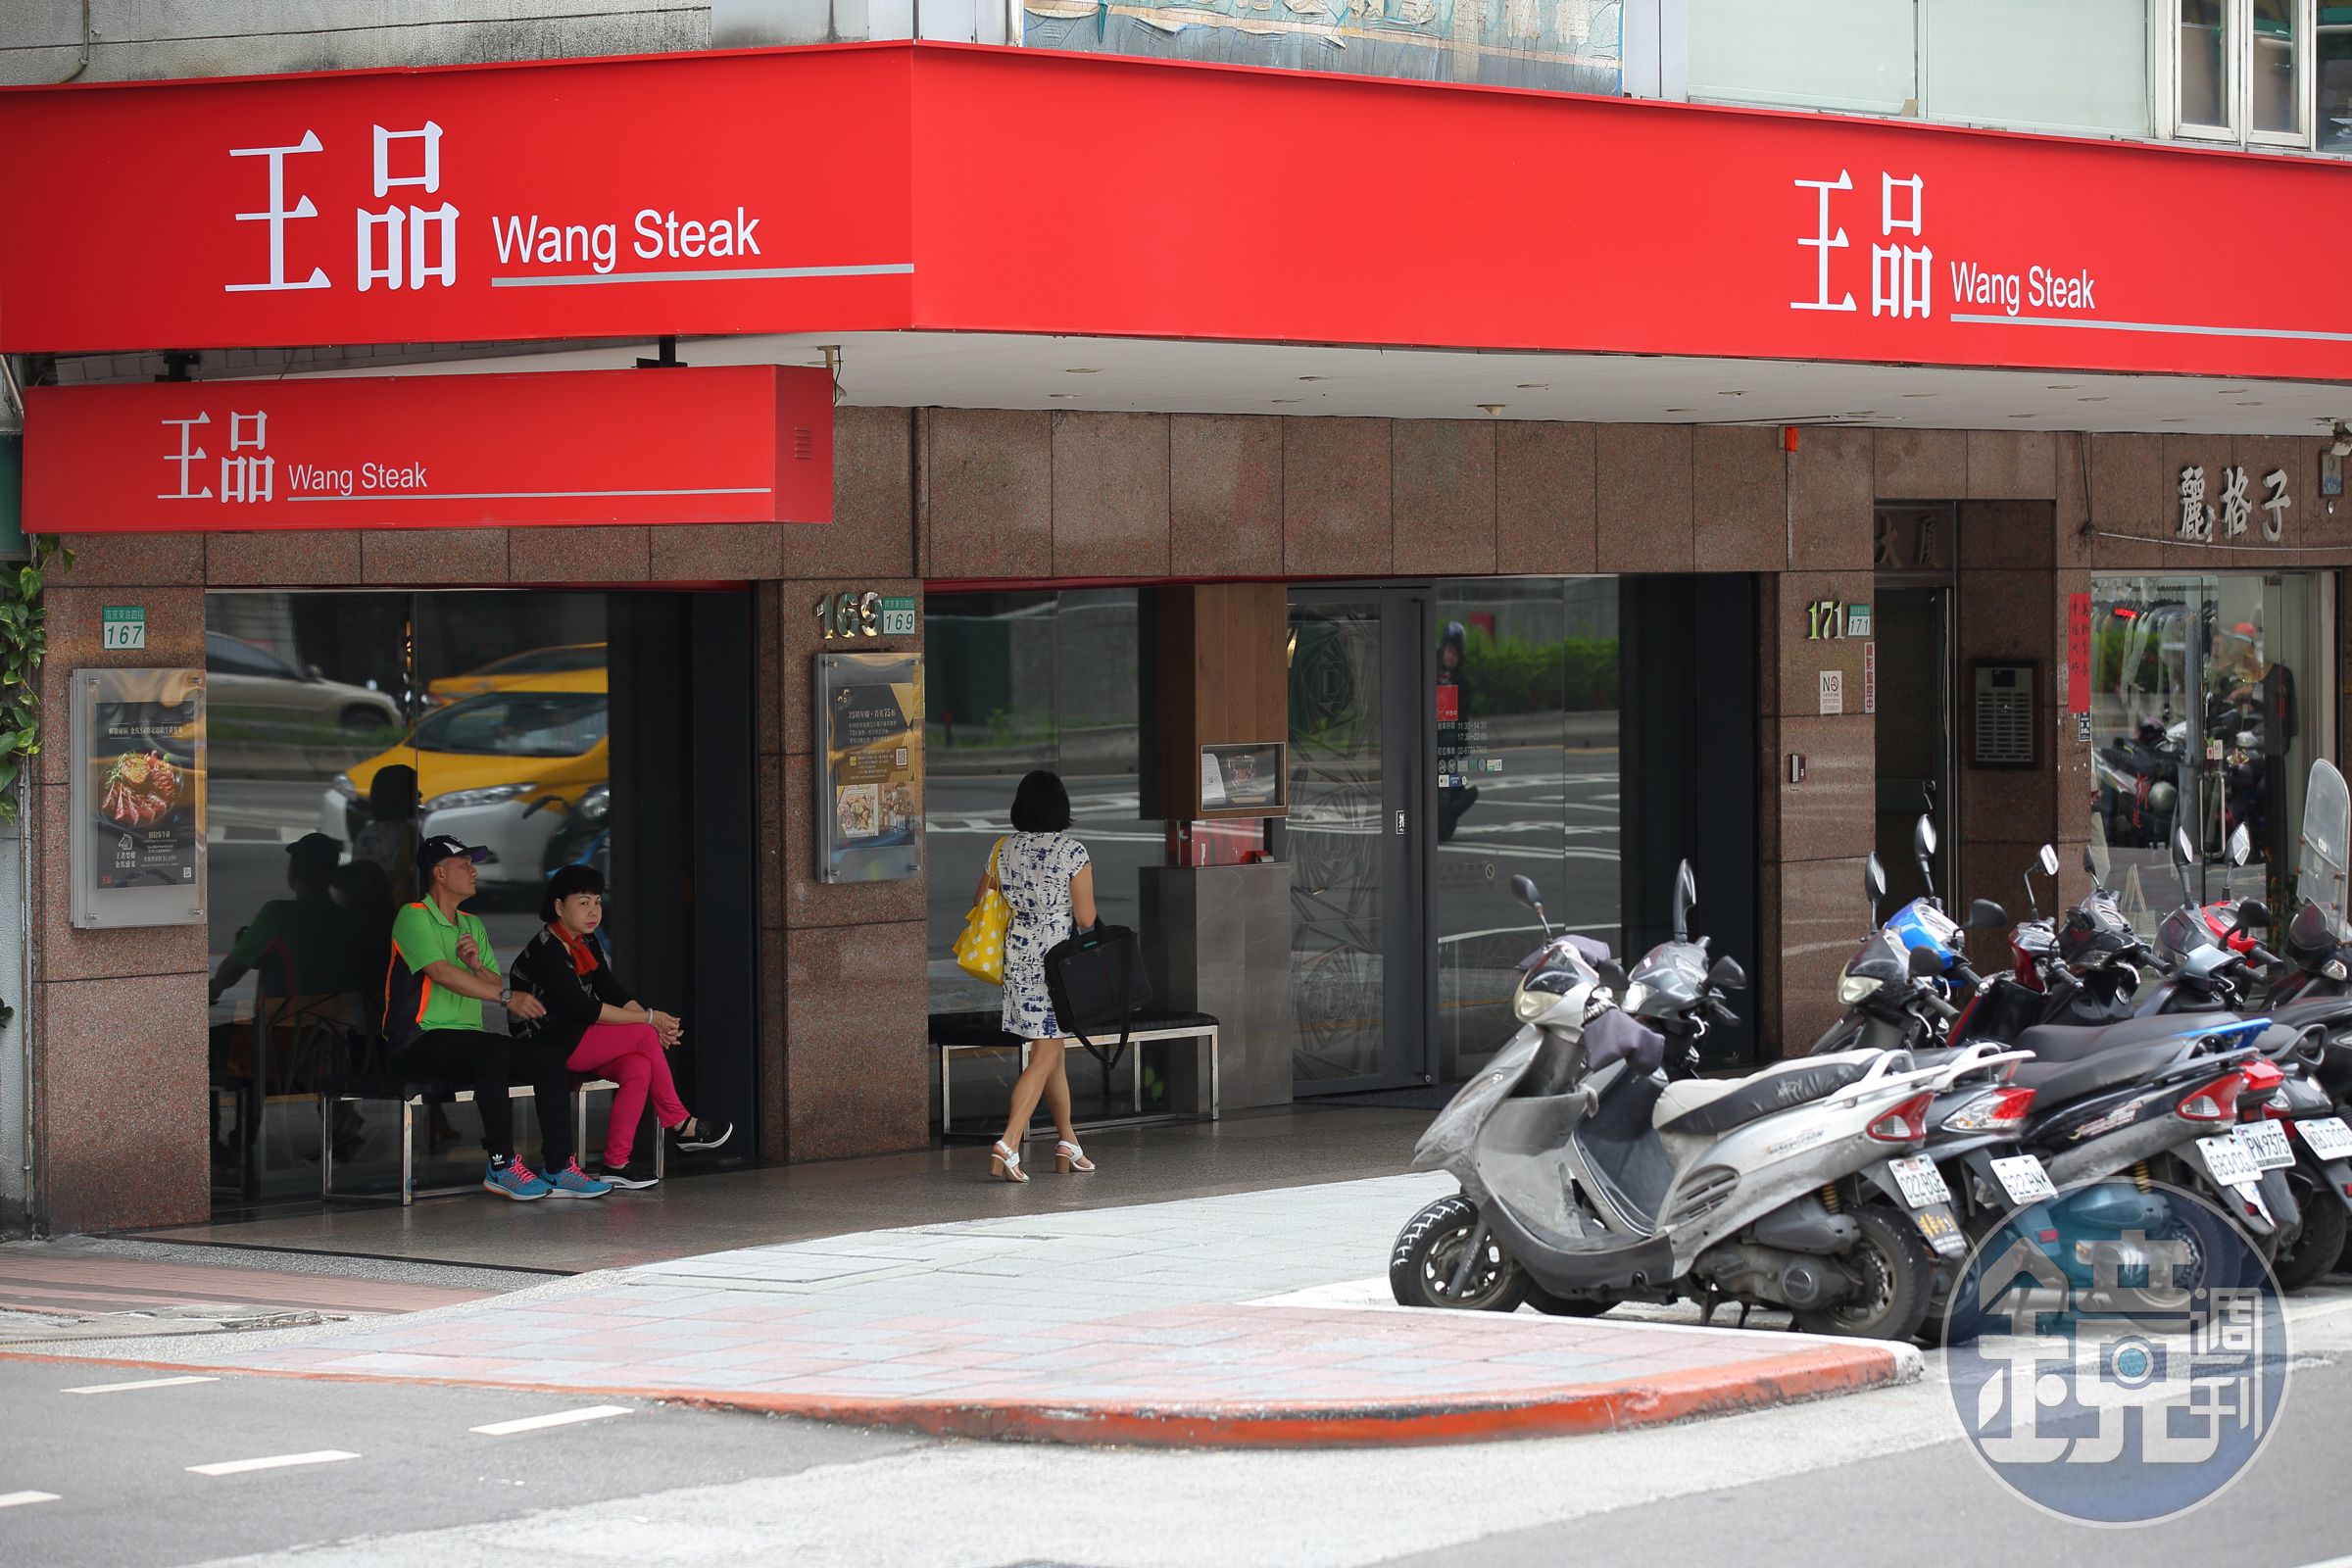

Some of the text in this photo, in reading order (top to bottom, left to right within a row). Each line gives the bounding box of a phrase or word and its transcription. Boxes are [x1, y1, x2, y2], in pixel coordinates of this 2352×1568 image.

[225, 121, 459, 291] 王品
[492, 207, 761, 274] Wang Steak
[1790, 170, 1933, 318] 王品
[1950, 261, 2095, 316] Wang Steak
[158, 411, 274, 503] 王品
[288, 462, 427, 496] Wang Steak
[817, 591, 882, 639] 169
[885, 612, 914, 631] 169
[1808, 601, 1845, 639] 171
[1849, 618, 1869, 633] 171
[108, 625, 143, 645] 167
[2243, 1132, 2290, 1159] PN-9375
[1900, 1169, 1946, 1199] 022-BGE
